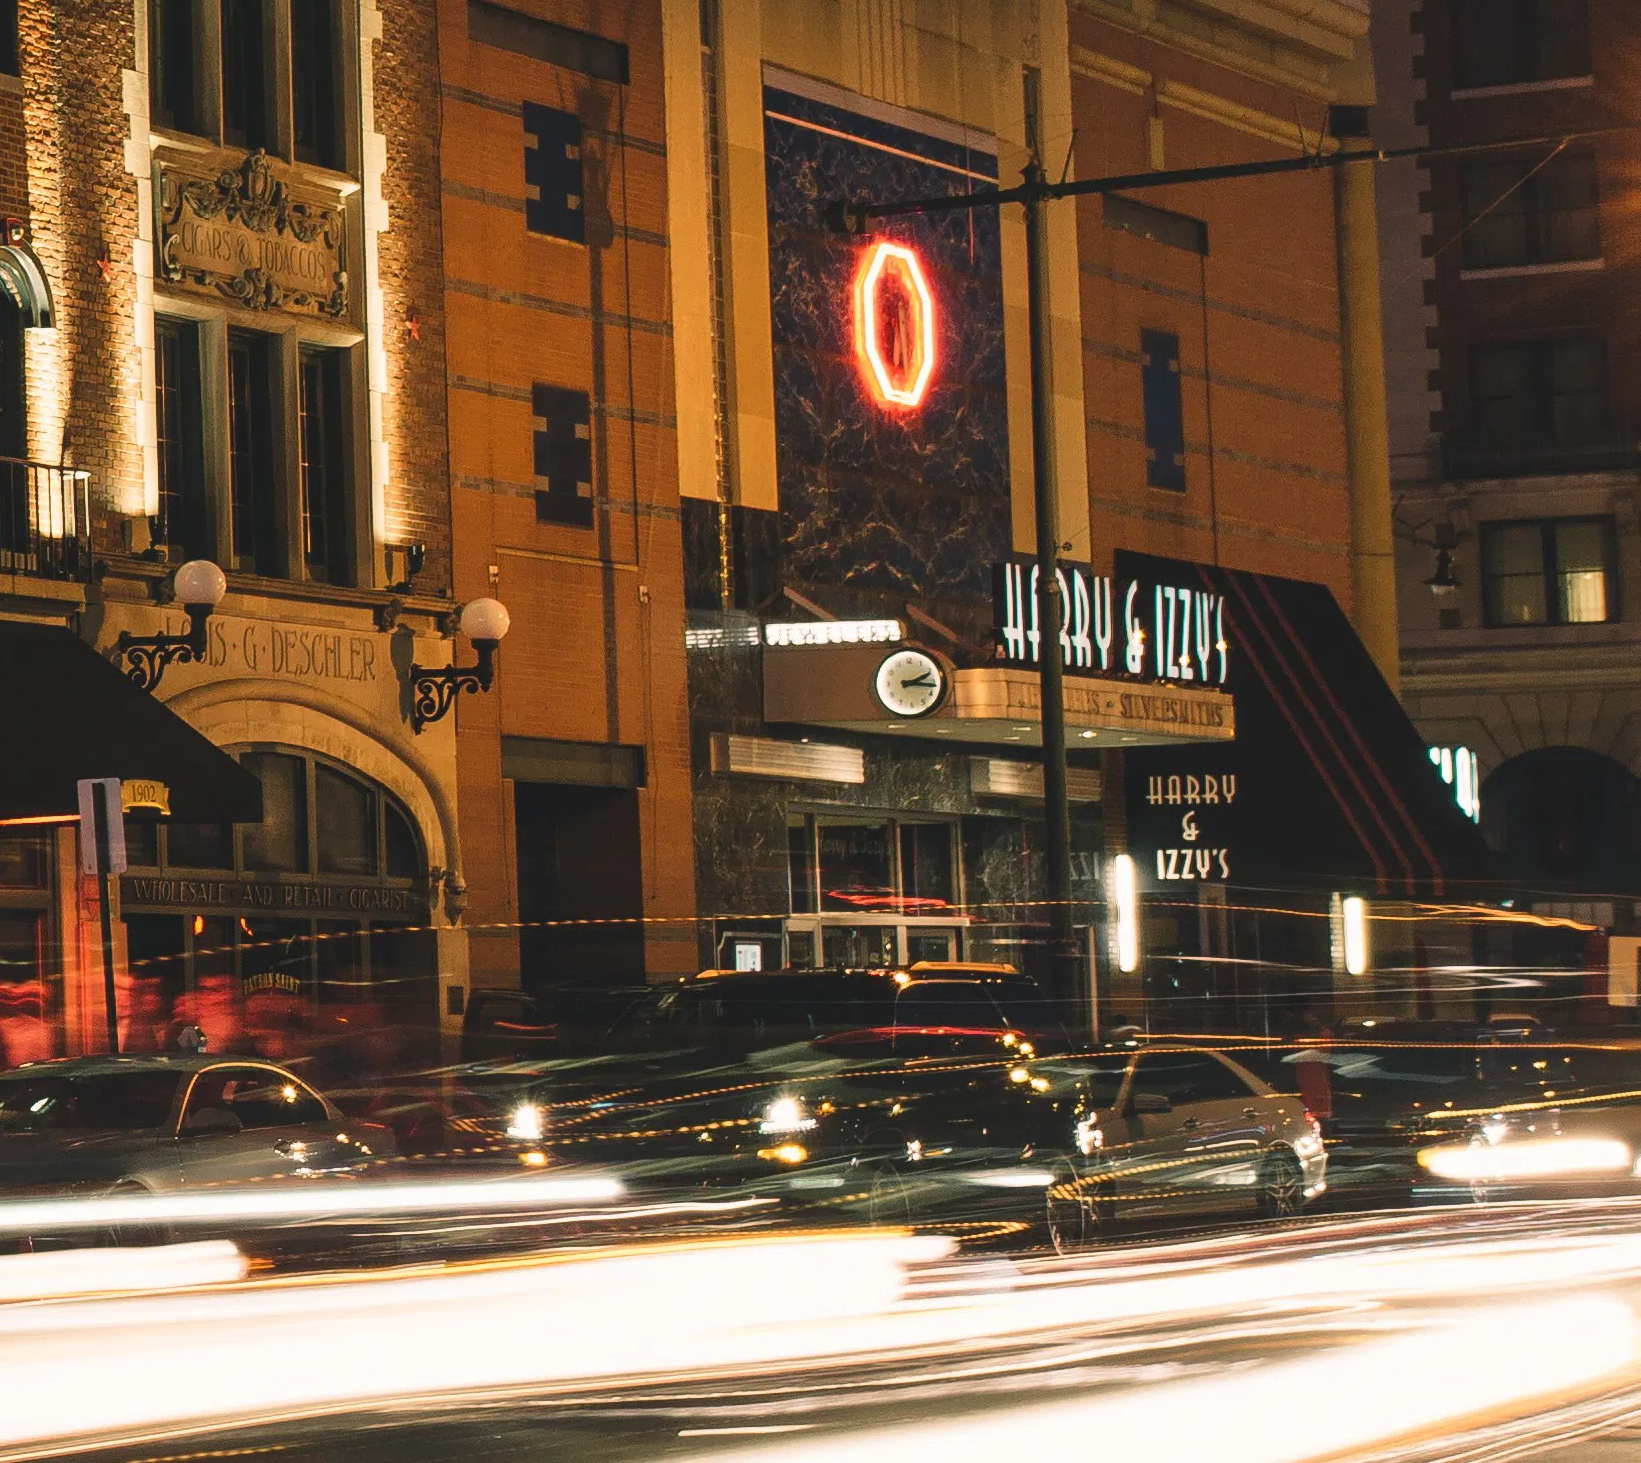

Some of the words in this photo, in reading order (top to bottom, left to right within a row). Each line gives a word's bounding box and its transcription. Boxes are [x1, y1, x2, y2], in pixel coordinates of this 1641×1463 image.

[180, 221, 232, 262] CIGARS
[257, 237, 326, 283] TOBACCOS
[1125, 579, 1145, 674] &
[1155, 583, 1228, 684] IZZY'S
[243, 625, 258, 671] G
[271, 626, 376, 682] DESCHLER
[131, 784, 157, 803] 1902
[1145, 774, 1238, 805] HARRY
[1181, 810, 1200, 841] &
[1156, 848, 1230, 880] IZZY'S
[133, 879, 228, 905] WHOLESALE
[242, 884, 273, 907] AND
[284, 886, 333, 908] RETAIL
[349, 887, 410, 911] CIGARIST
